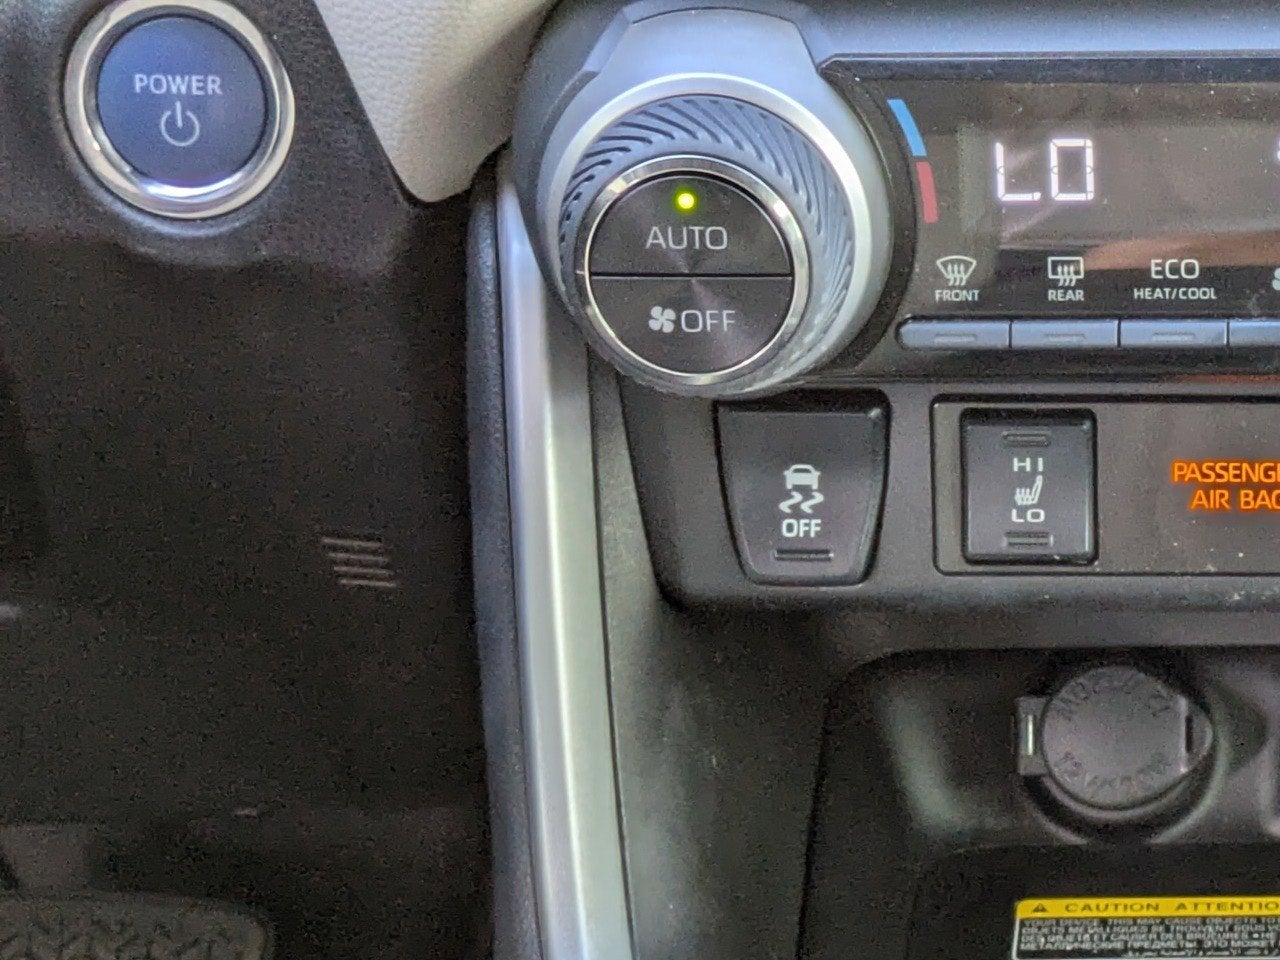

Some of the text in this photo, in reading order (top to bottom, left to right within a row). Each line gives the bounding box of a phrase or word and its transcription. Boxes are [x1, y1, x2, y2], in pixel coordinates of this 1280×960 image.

[133, 74, 222, 96] POWER
[995, 138, 1095, 201] LO
[645, 225, 729, 250] AUTO
[1150, 258, 1200, 280] ECO
[934, 289, 980, 302] FRONT
[1047, 288, 1085, 302] REAR
[1133, 287, 1217, 300] HEAT/COOL
[680, 310, 736, 333] OFF
[1012, 457, 1044, 473] HI
[1189, 489, 1232, 511] AIR
[1011, 507, 1046, 523] LO
[781, 518, 822, 538] OFF
[1065, 902, 1160, 913] CAUTION
